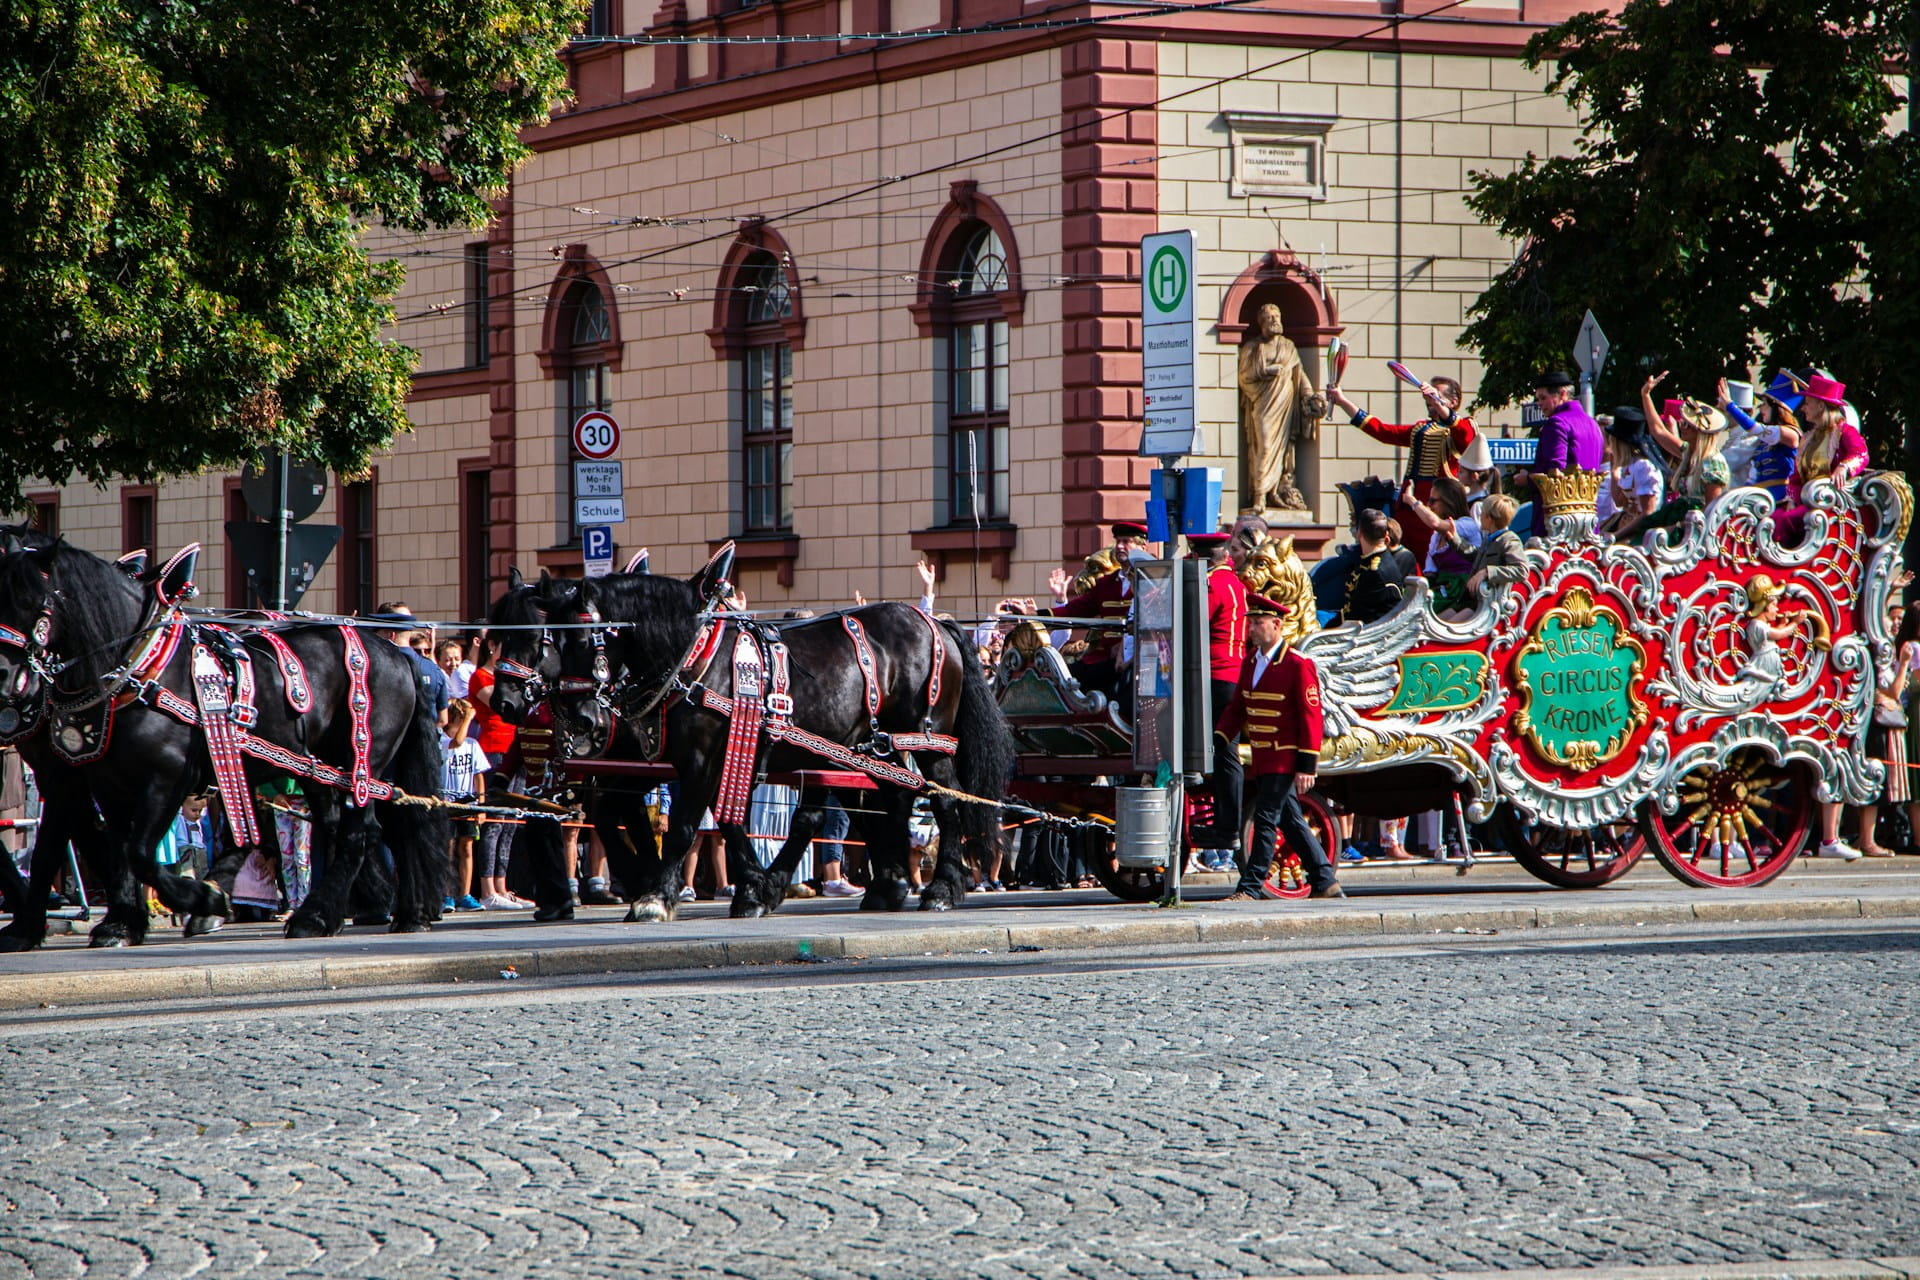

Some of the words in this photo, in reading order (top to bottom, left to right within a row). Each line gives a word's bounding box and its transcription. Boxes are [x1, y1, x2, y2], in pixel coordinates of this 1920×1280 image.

[1160, 259, 1175, 298] H
[1148, 339, 1188, 350] Maxmonument
[585, 425, 611, 446] 30
[580, 465, 619, 475] werktags
[586, 475, 613, 484] Mo-Fr
[589, 485, 611, 493] 7-18h
[582, 506, 620, 517] Schule
[590, 530, 605, 557] P
[1544, 630, 1615, 663] RIESEN
[1540, 666, 1623, 696] CIRCUS
[1542, 698, 1622, 733] KRONE
